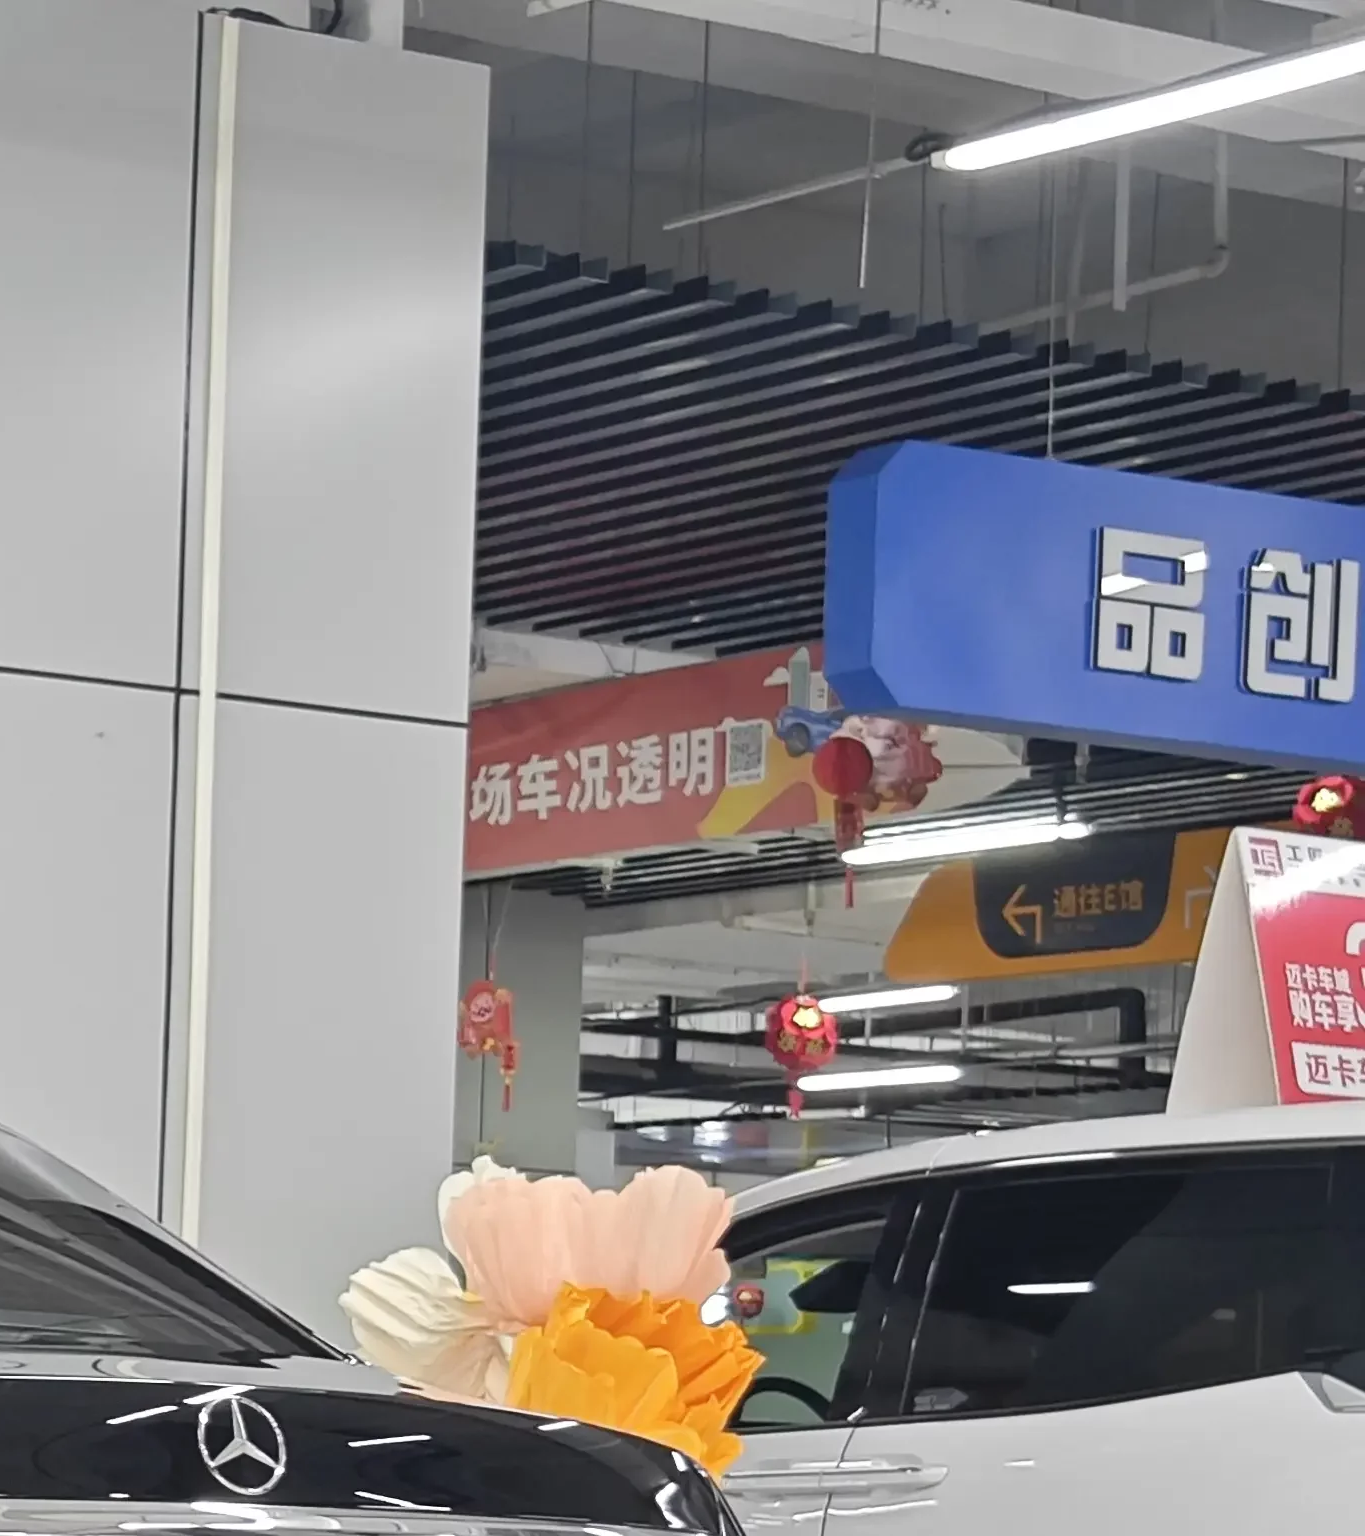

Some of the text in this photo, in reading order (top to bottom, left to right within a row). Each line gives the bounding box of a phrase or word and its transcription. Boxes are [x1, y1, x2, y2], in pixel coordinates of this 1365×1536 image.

[1096, 525, 1361, 704] 品创
[469, 725, 716, 828] 场车况透明
[1053, 880, 1144, 918] 通往E馆
